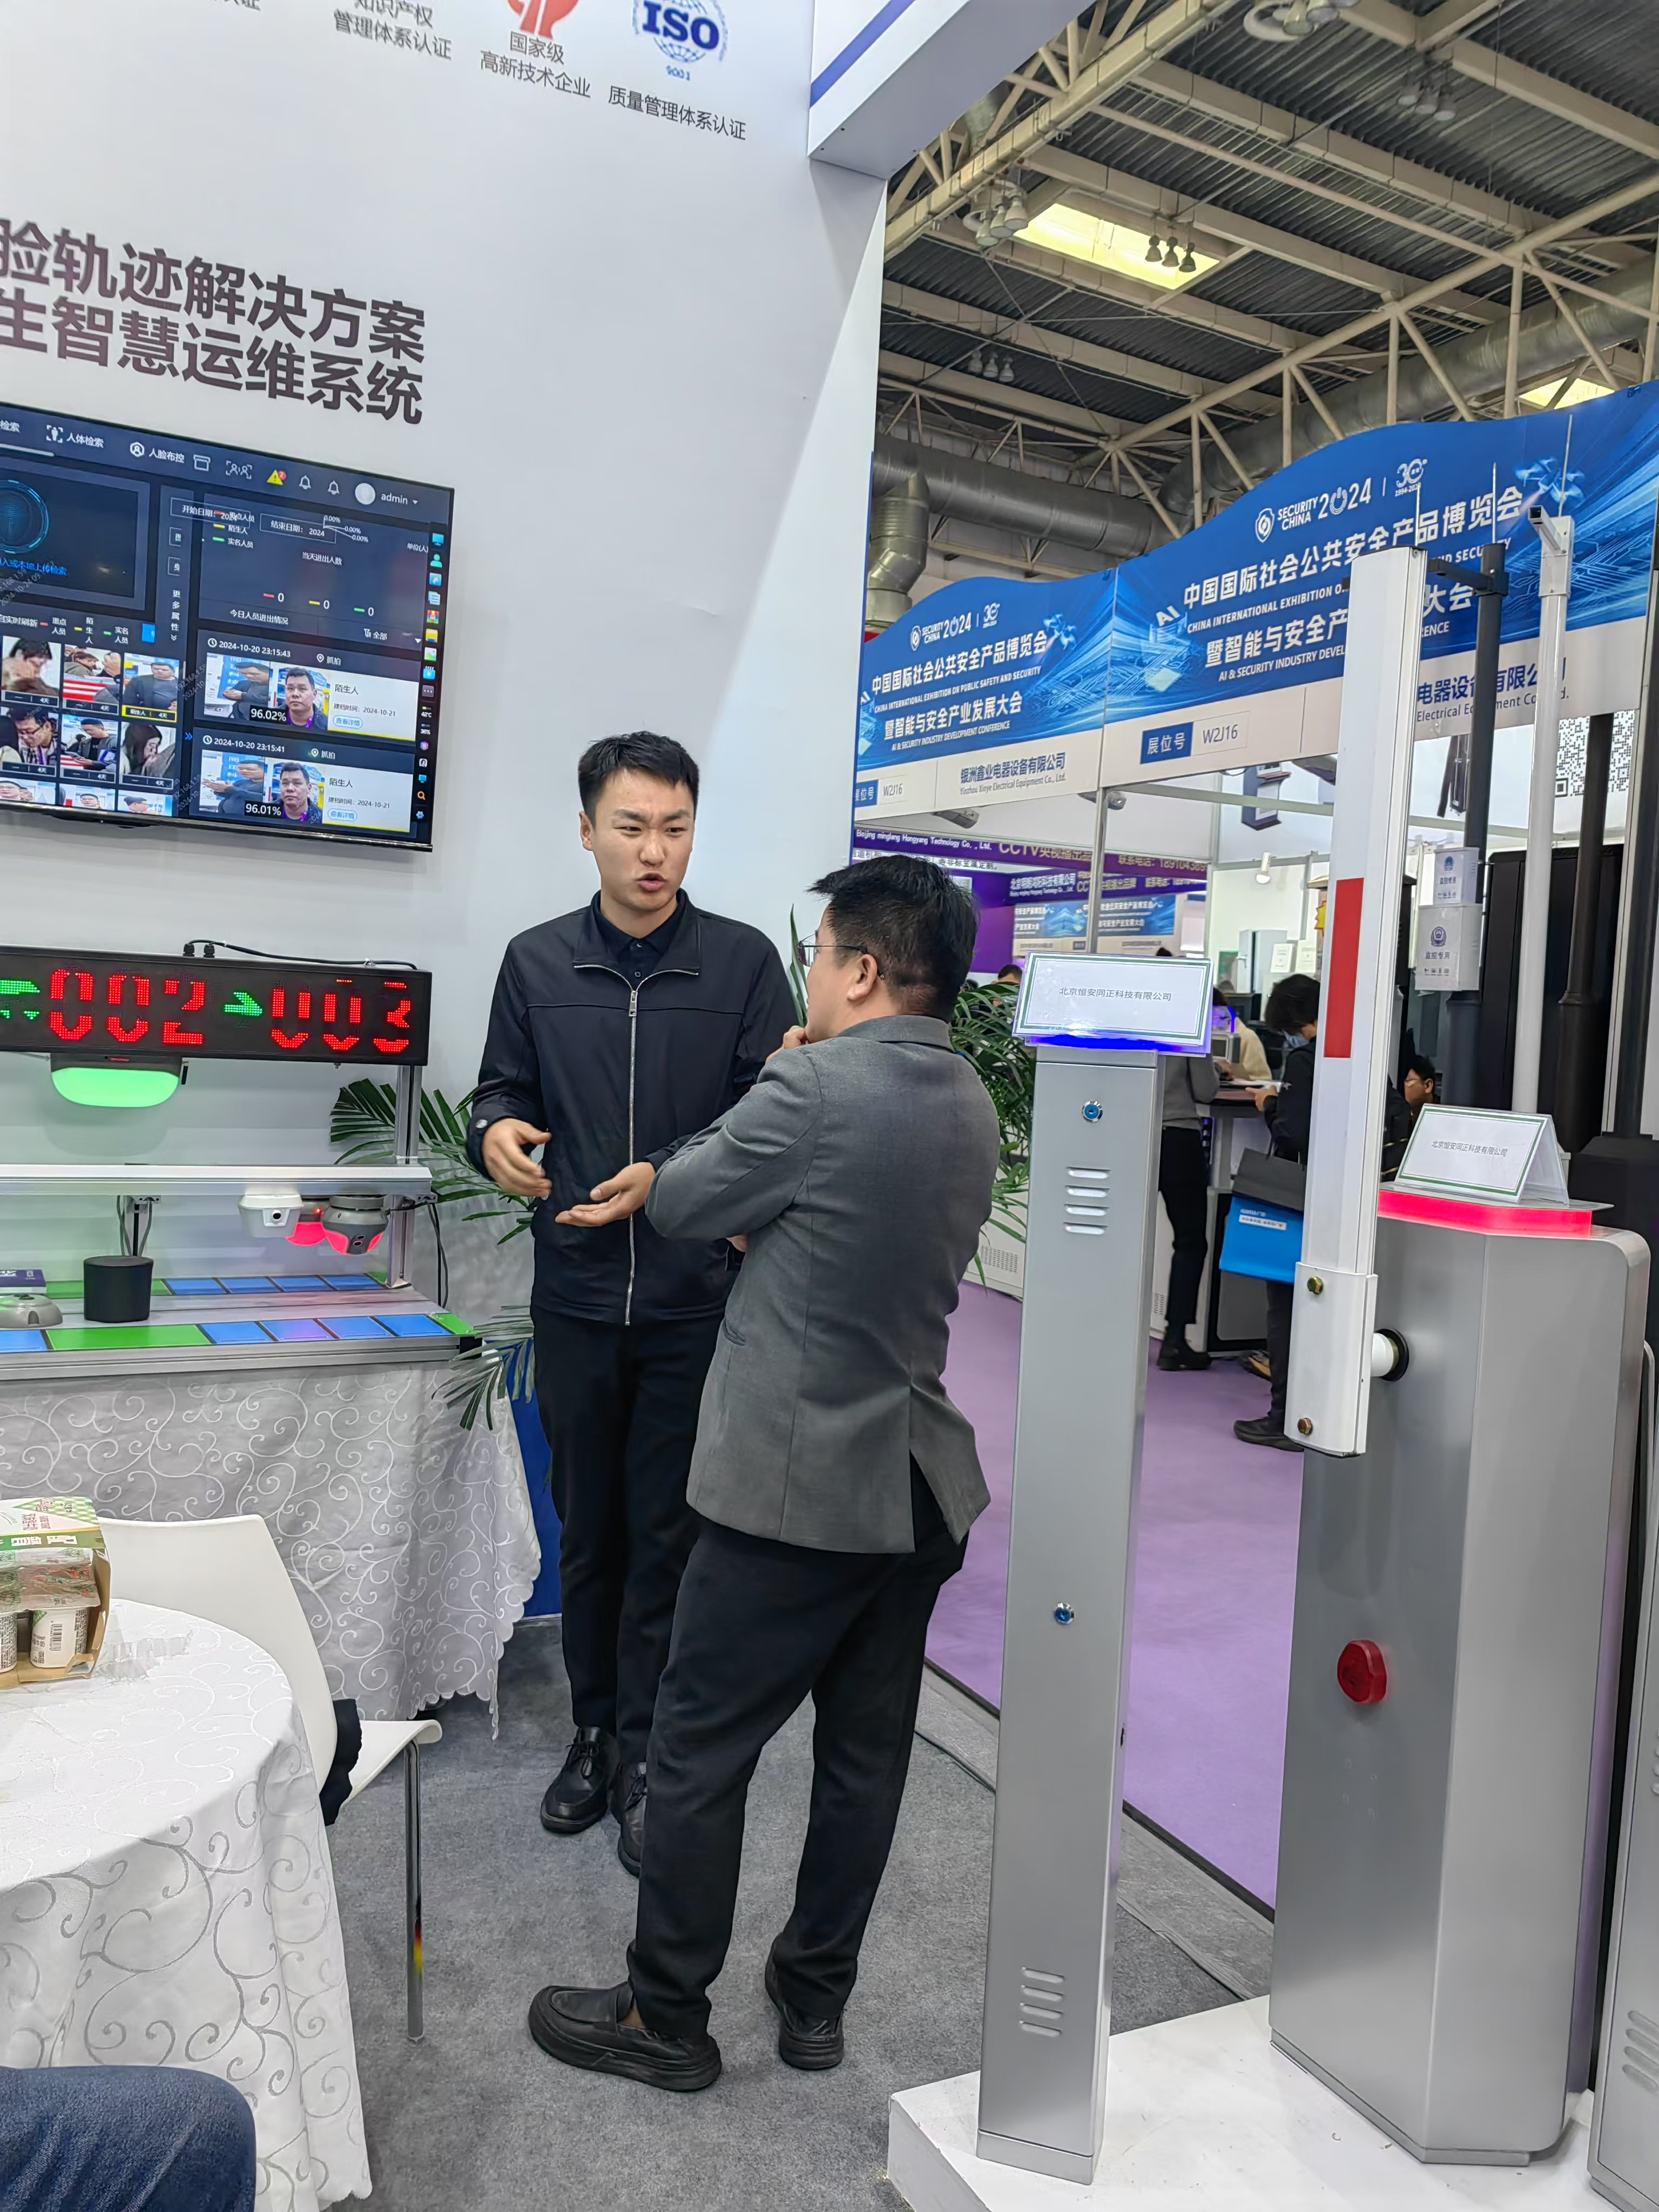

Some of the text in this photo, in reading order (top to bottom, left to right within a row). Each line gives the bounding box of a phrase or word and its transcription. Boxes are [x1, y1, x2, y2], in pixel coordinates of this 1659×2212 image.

[643, 1, 719, 50] ISO
[333, 8, 451, 60] 管理体系认证
[510, 31, 565, 65] 国家级
[480, 50, 590, 99] 高新技术企业
[608, 85, 746, 140] 质量管理体系认证
[0, 219, 424, 363] 脸轨迹解决方案
[0, 420, 20, 433] 检索
[67, 432, 104, 448] 人体检索
[149, 448, 185, 463] 人脸布控
[381, 493, 408, 504] admin
[1277, 477, 1372, 521] SECURITY 2024
[324, 515, 341, 523] 0.00%
[1282, 511, 1311, 530] CHINA
[309, 528, 325, 537] 2024
[345, 526, 361, 534] 0.00%
[228, 537, 254, 548] 实名人员
[1183, 485, 1523, 610] 中国国际社会公共安全产品博览会
[0, 557, 67, 576] 入或本地上传检索
[302, 551, 342, 566] 当天进出人数
[278, 594, 284, 602] 0
[323, 600, 329, 609] 0
[368, 608, 374, 616] 0
[1156, 605, 1181, 626] AI
[1187, 618, 1211, 633] CHINA
[1212, 601, 1278, 629] INTERNATIONAL
[1280, 587, 1332, 610] EXHIBITION
[1334, 583, 1349, 595] O
[230, 609, 289, 625] 今日人员进出情况
[922, 612, 972, 638] SECURITY 2024
[373, 631, 388, 640] 全部
[924, 631, 940, 644] CHINA
[219, 641, 291, 658] 2024-10-20 23:15:43
[327, 656, 341, 665] 抓拍
[872, 630, 1048, 696] 中国国际社会公共安全产品博览会
[1219, 671, 1228, 682] AI
[1229, 670, 1236, 679] &
[1237, 659, 1273, 678] SECURITY
[1275, 650, 1317, 670] INDUSTRY
[335, 684, 359, 695] 陌生人
[875, 704, 888, 713] CHINA
[889, 697, 923, 710] INTERNATIONAL
[924, 690, 952, 702] EXHIBITION
[961, 682, 979, 693] PUBLIC
[980, 676, 1000, 688] SAFETY
[1000, 674, 1012, 683] AND
[1013, 666, 1041, 680] SECURITY
[251, 708, 287, 721] 96.02%
[363, 707, 395, 717] 2024-10-21
[884, 691, 1022, 741] 暨智能与安全产业发展大会
[1417, 705, 1460, 722] Electrical
[902, 738, 921, 748] SECURITY
[922, 733, 944, 745] INDUSTRY
[945, 727, 977, 740] DEVELOPMENT
[978, 720, 1010, 734] CONFERENCE
[1202, 724, 1238, 745] W2J16
[214, 738, 285, 753] 2024-10-20 23:15:41
[1148, 732, 1186, 756] 展位号
[321, 750, 335, 759] 抓拍
[329, 778, 353, 788] 陌生人
[884, 783, 903, 797] W2J16
[245, 804, 281, 815] 96.01%
[358, 800, 390, 809] 2024-10-21
[857, 830, 875, 839] Beijing
[878, 832, 900, 842] minglang
[902, 834, 928, 845] Hongyang
[930, 837, 960, 847] Technology
[980, 842, 992, 851] Ltd.
[1425, 952, 1450, 960] 监控专用
[1058, 987, 1172, 1001] 北京恒安同正科技有限公司
[50, 965, 206, 1046] 002
[1431, 1140, 1508, 1157] 北京恒安同正科技有限公司
